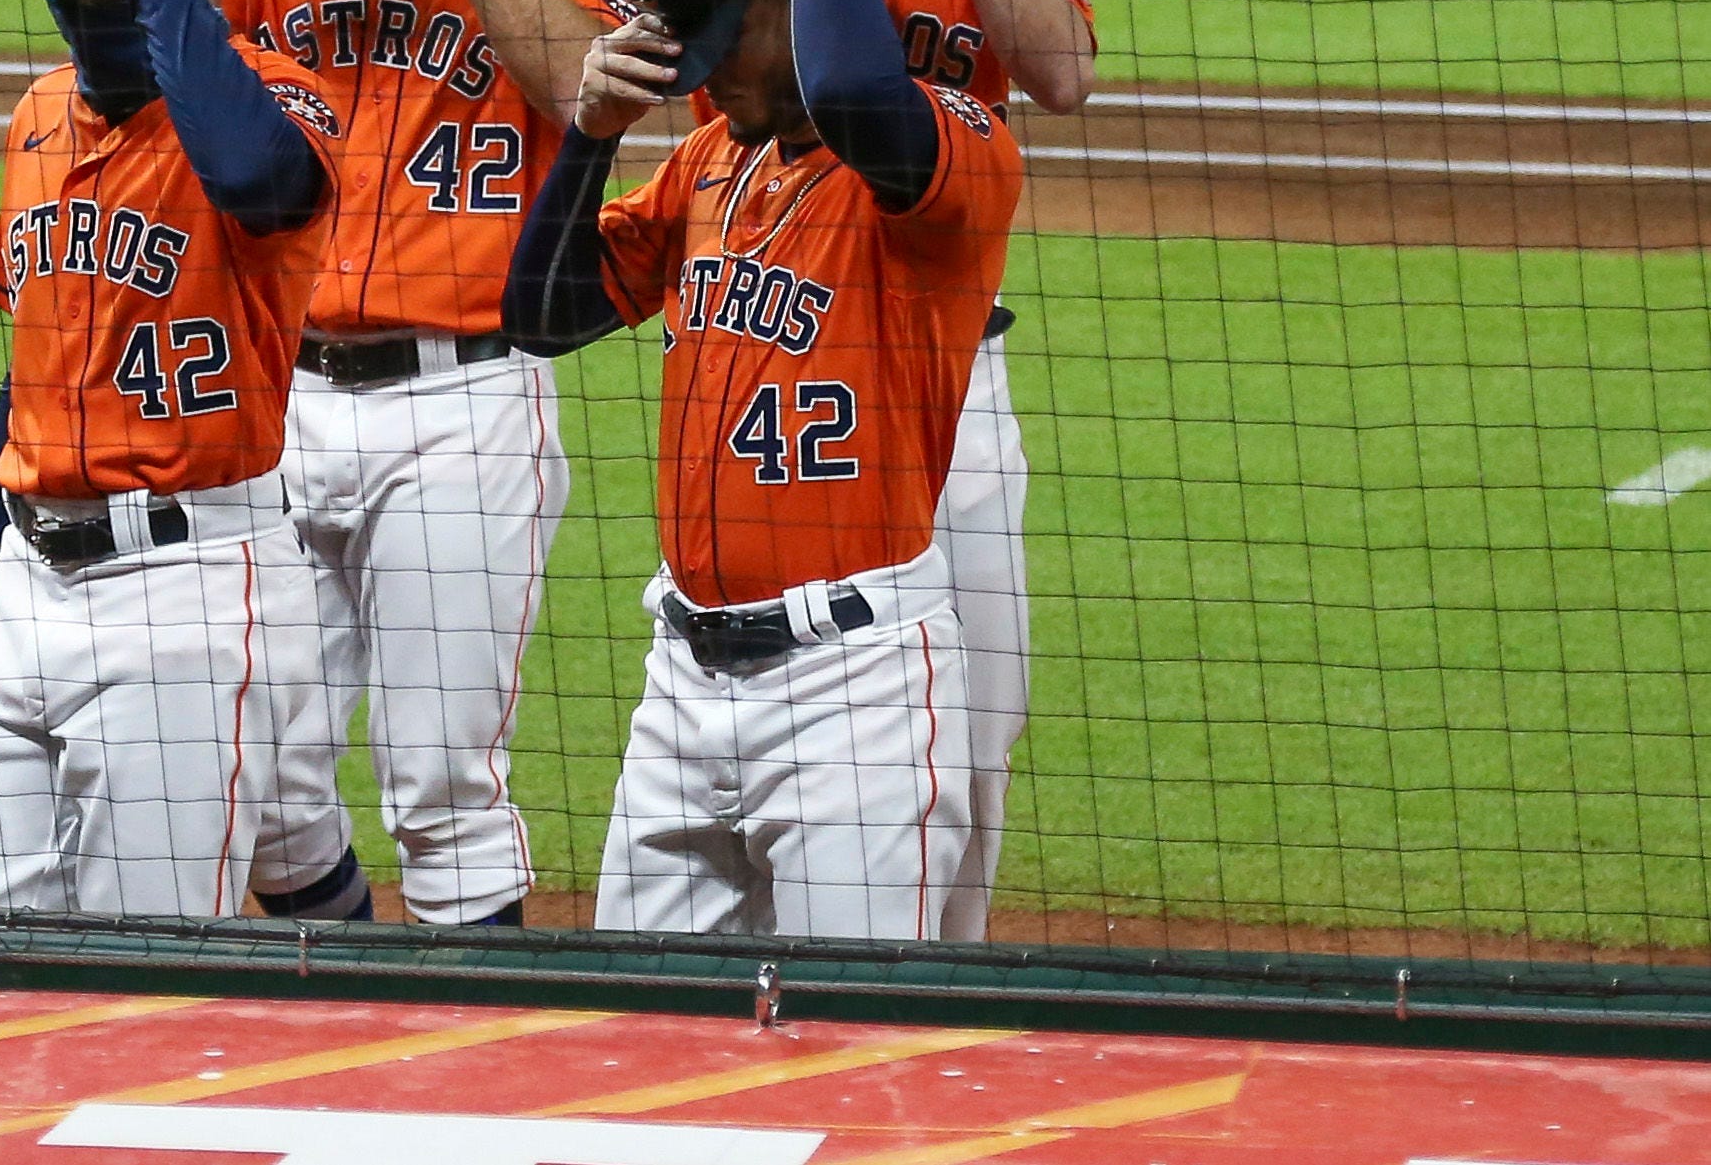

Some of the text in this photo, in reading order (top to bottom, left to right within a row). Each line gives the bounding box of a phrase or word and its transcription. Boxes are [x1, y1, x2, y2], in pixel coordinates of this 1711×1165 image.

[404, 121, 523, 214] 42
[113, 316, 237, 420] 42
[727, 380, 860, 485] 42
